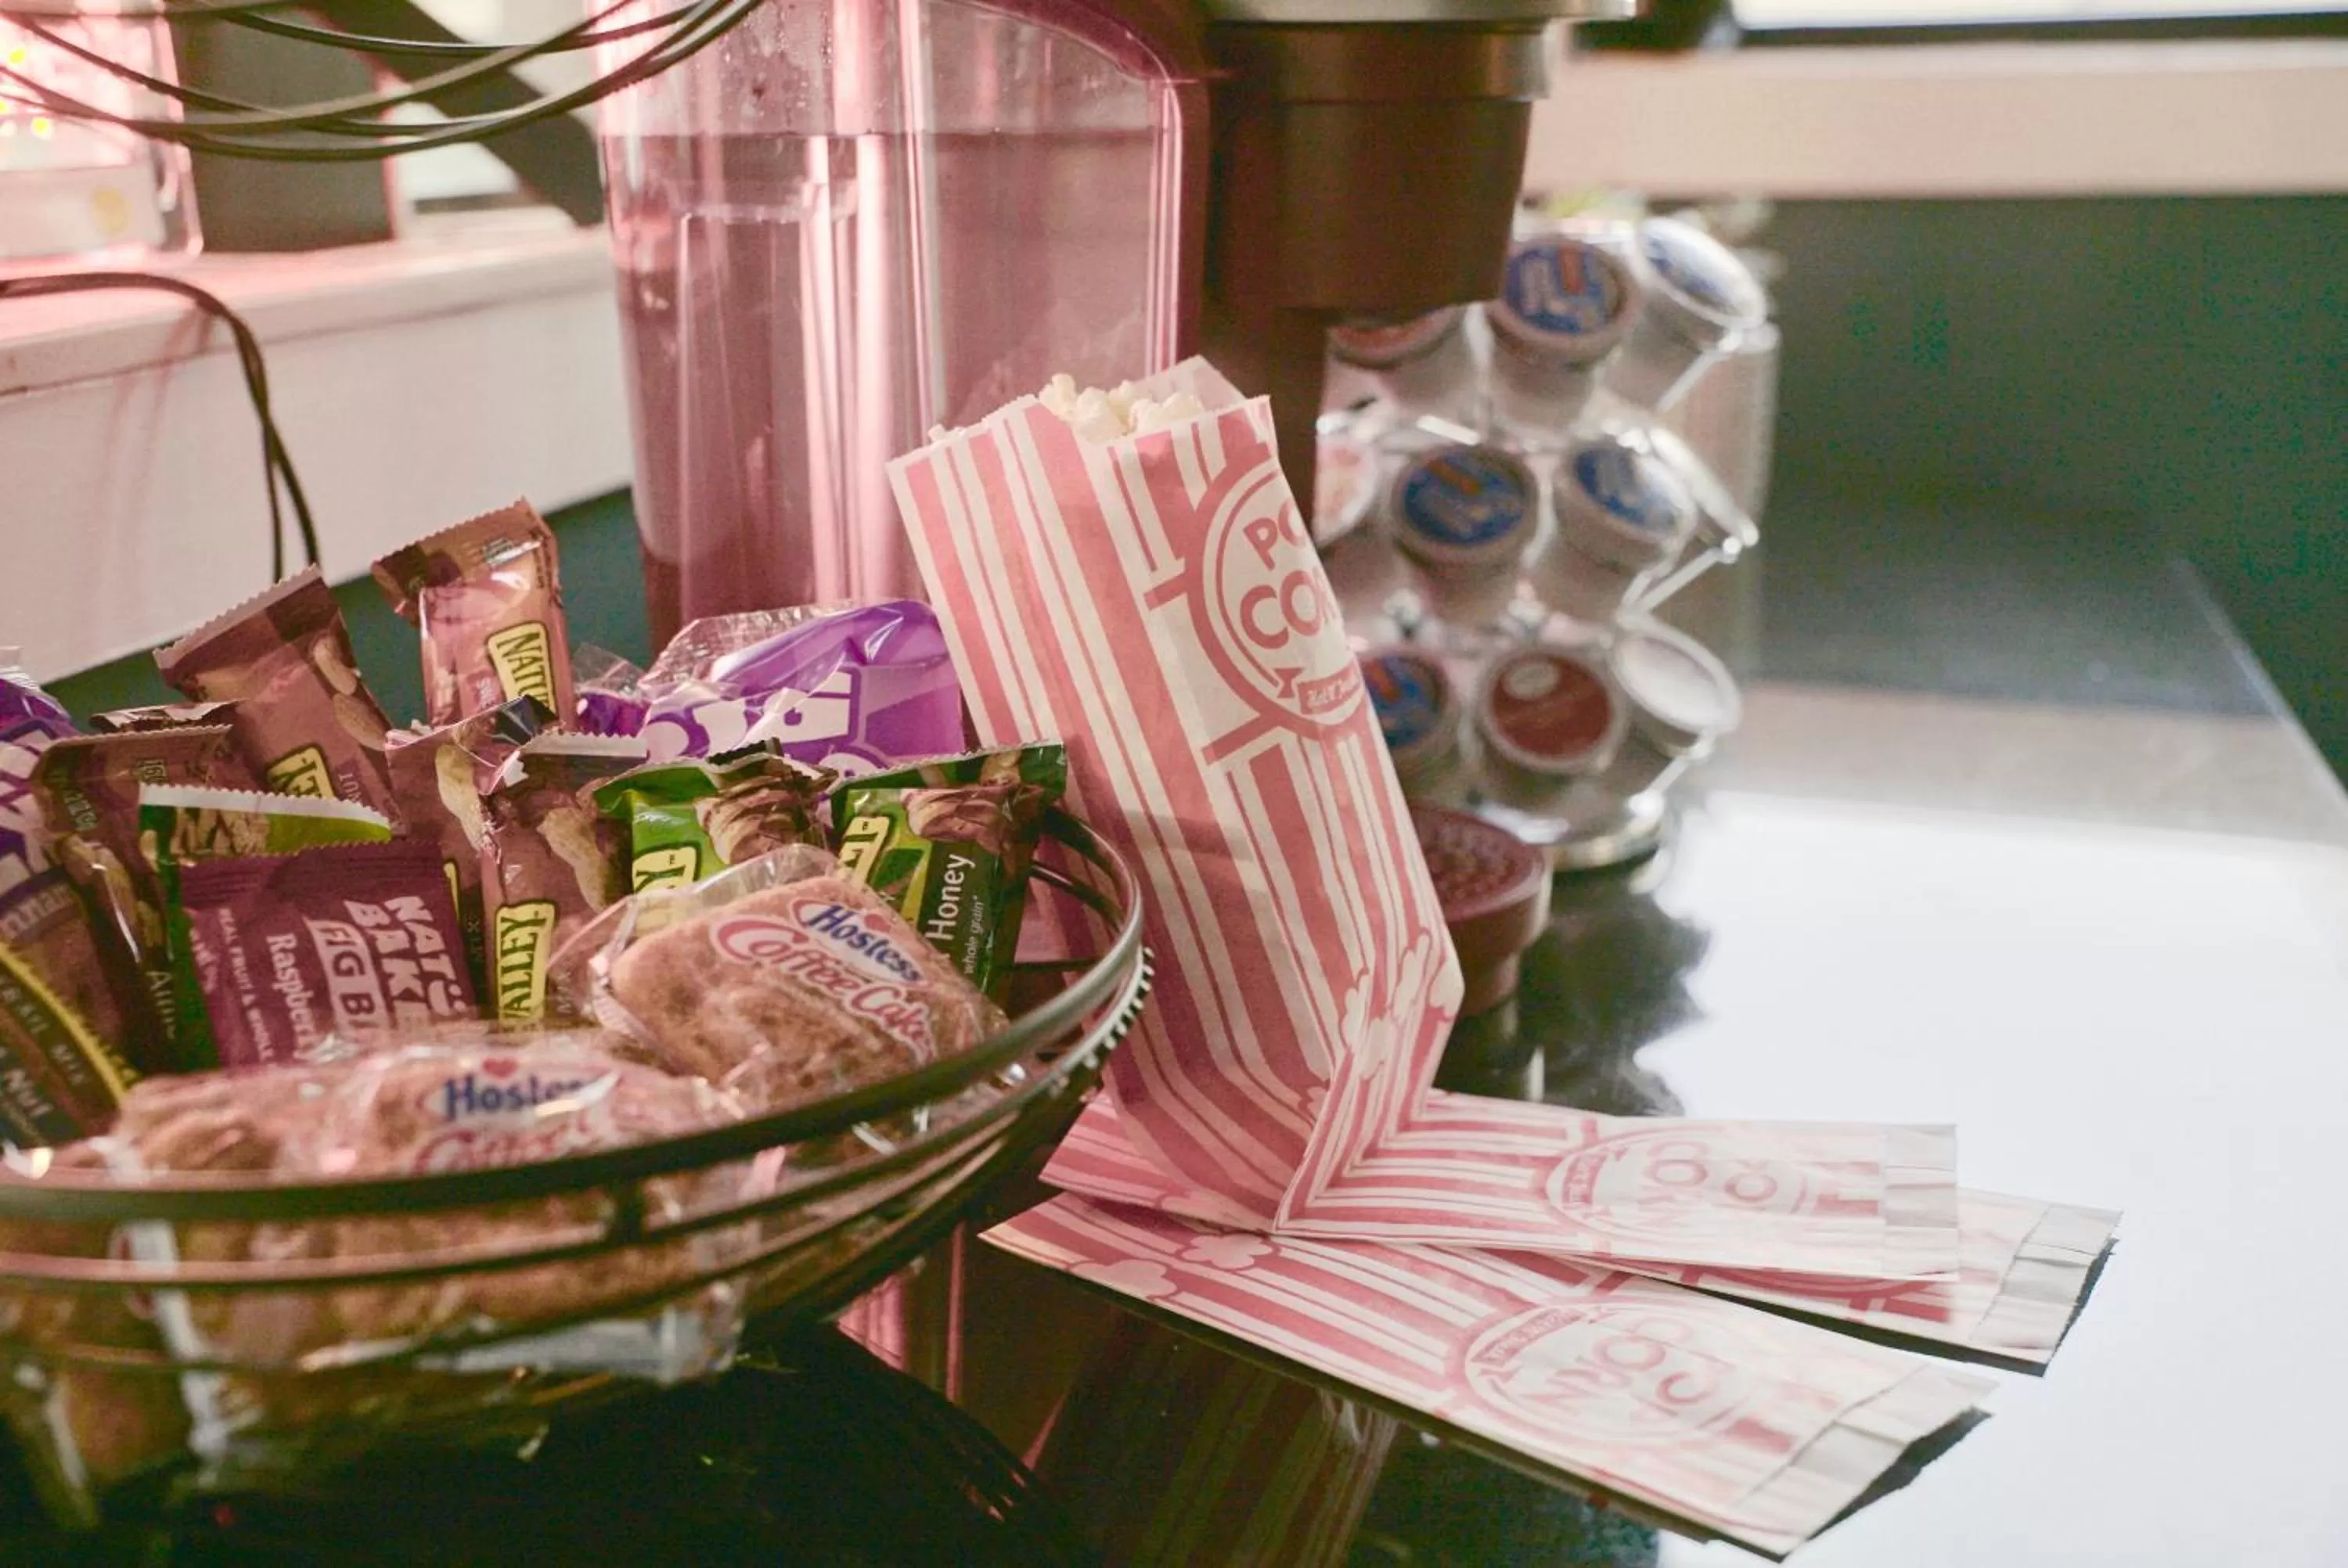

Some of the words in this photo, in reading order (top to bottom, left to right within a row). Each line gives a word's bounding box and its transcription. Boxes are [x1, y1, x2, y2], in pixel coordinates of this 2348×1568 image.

[1243, 498, 1305, 570] PO
[1240, 565, 1337, 649] CO
[496, 631, 551, 707] NATU
[926, 854, 976, 940] Honey
[317, 925, 366, 978] FIG
[717, 919, 862, 991] Coffee
[807, 904, 922, 983] Hostess
